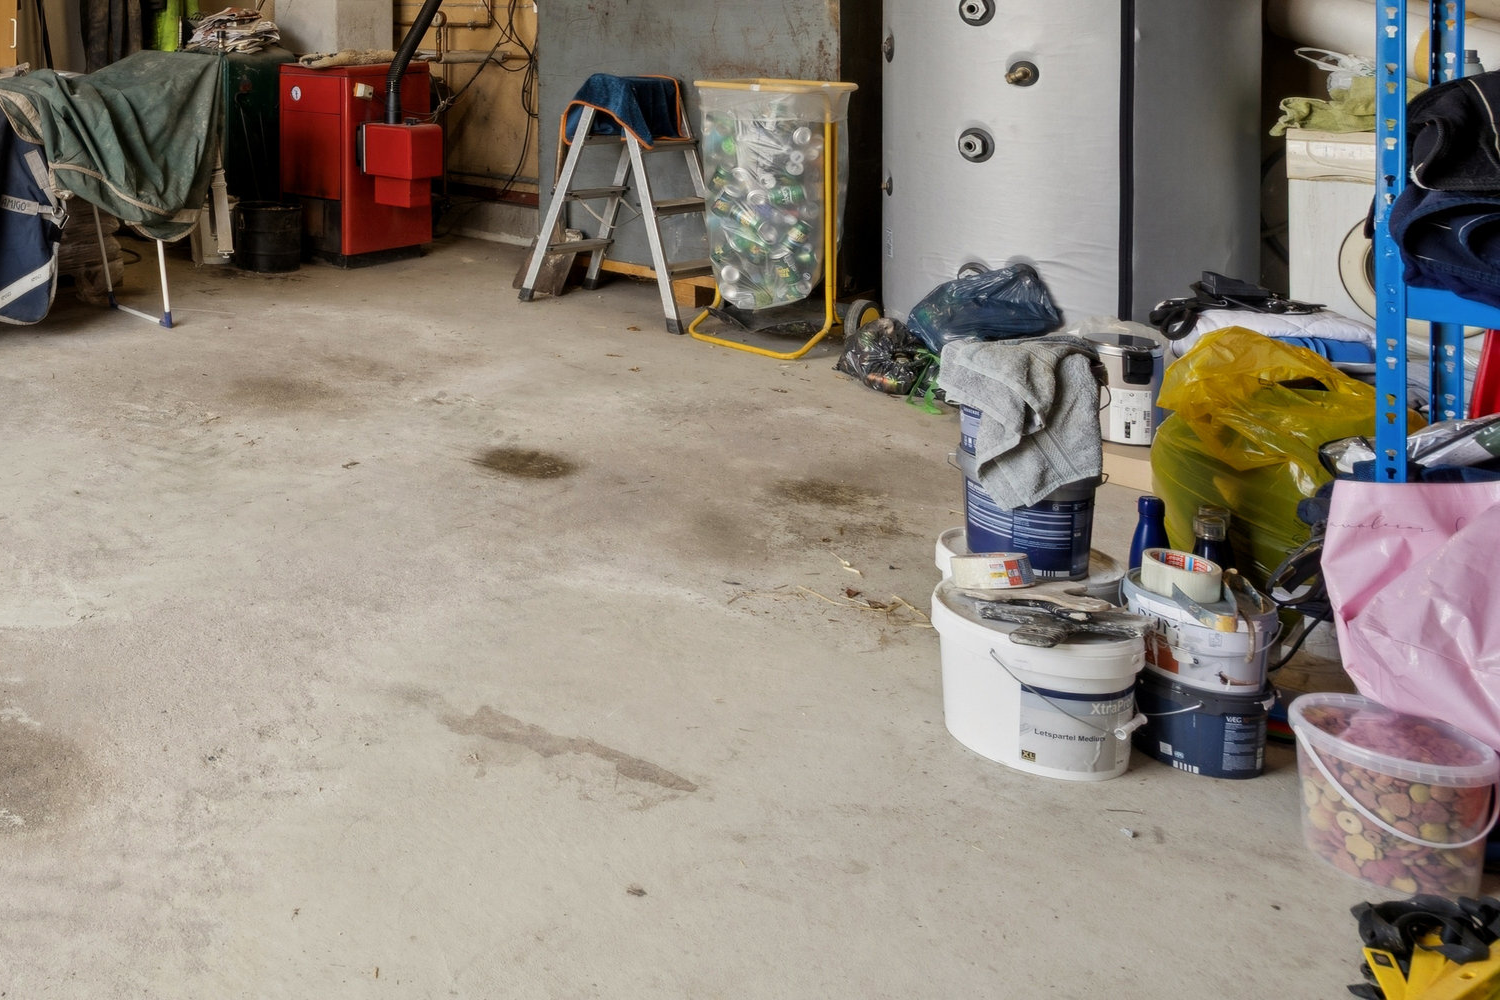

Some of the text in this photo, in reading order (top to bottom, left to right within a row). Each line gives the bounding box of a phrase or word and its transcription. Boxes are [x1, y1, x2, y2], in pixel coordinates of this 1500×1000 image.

[2, 197, 27, 212] AMIGO
[1225, 715, 1243, 724] VÆG
[1033, 727, 1077, 742] Letspartel
[1022, 750, 1036, 760] XL
